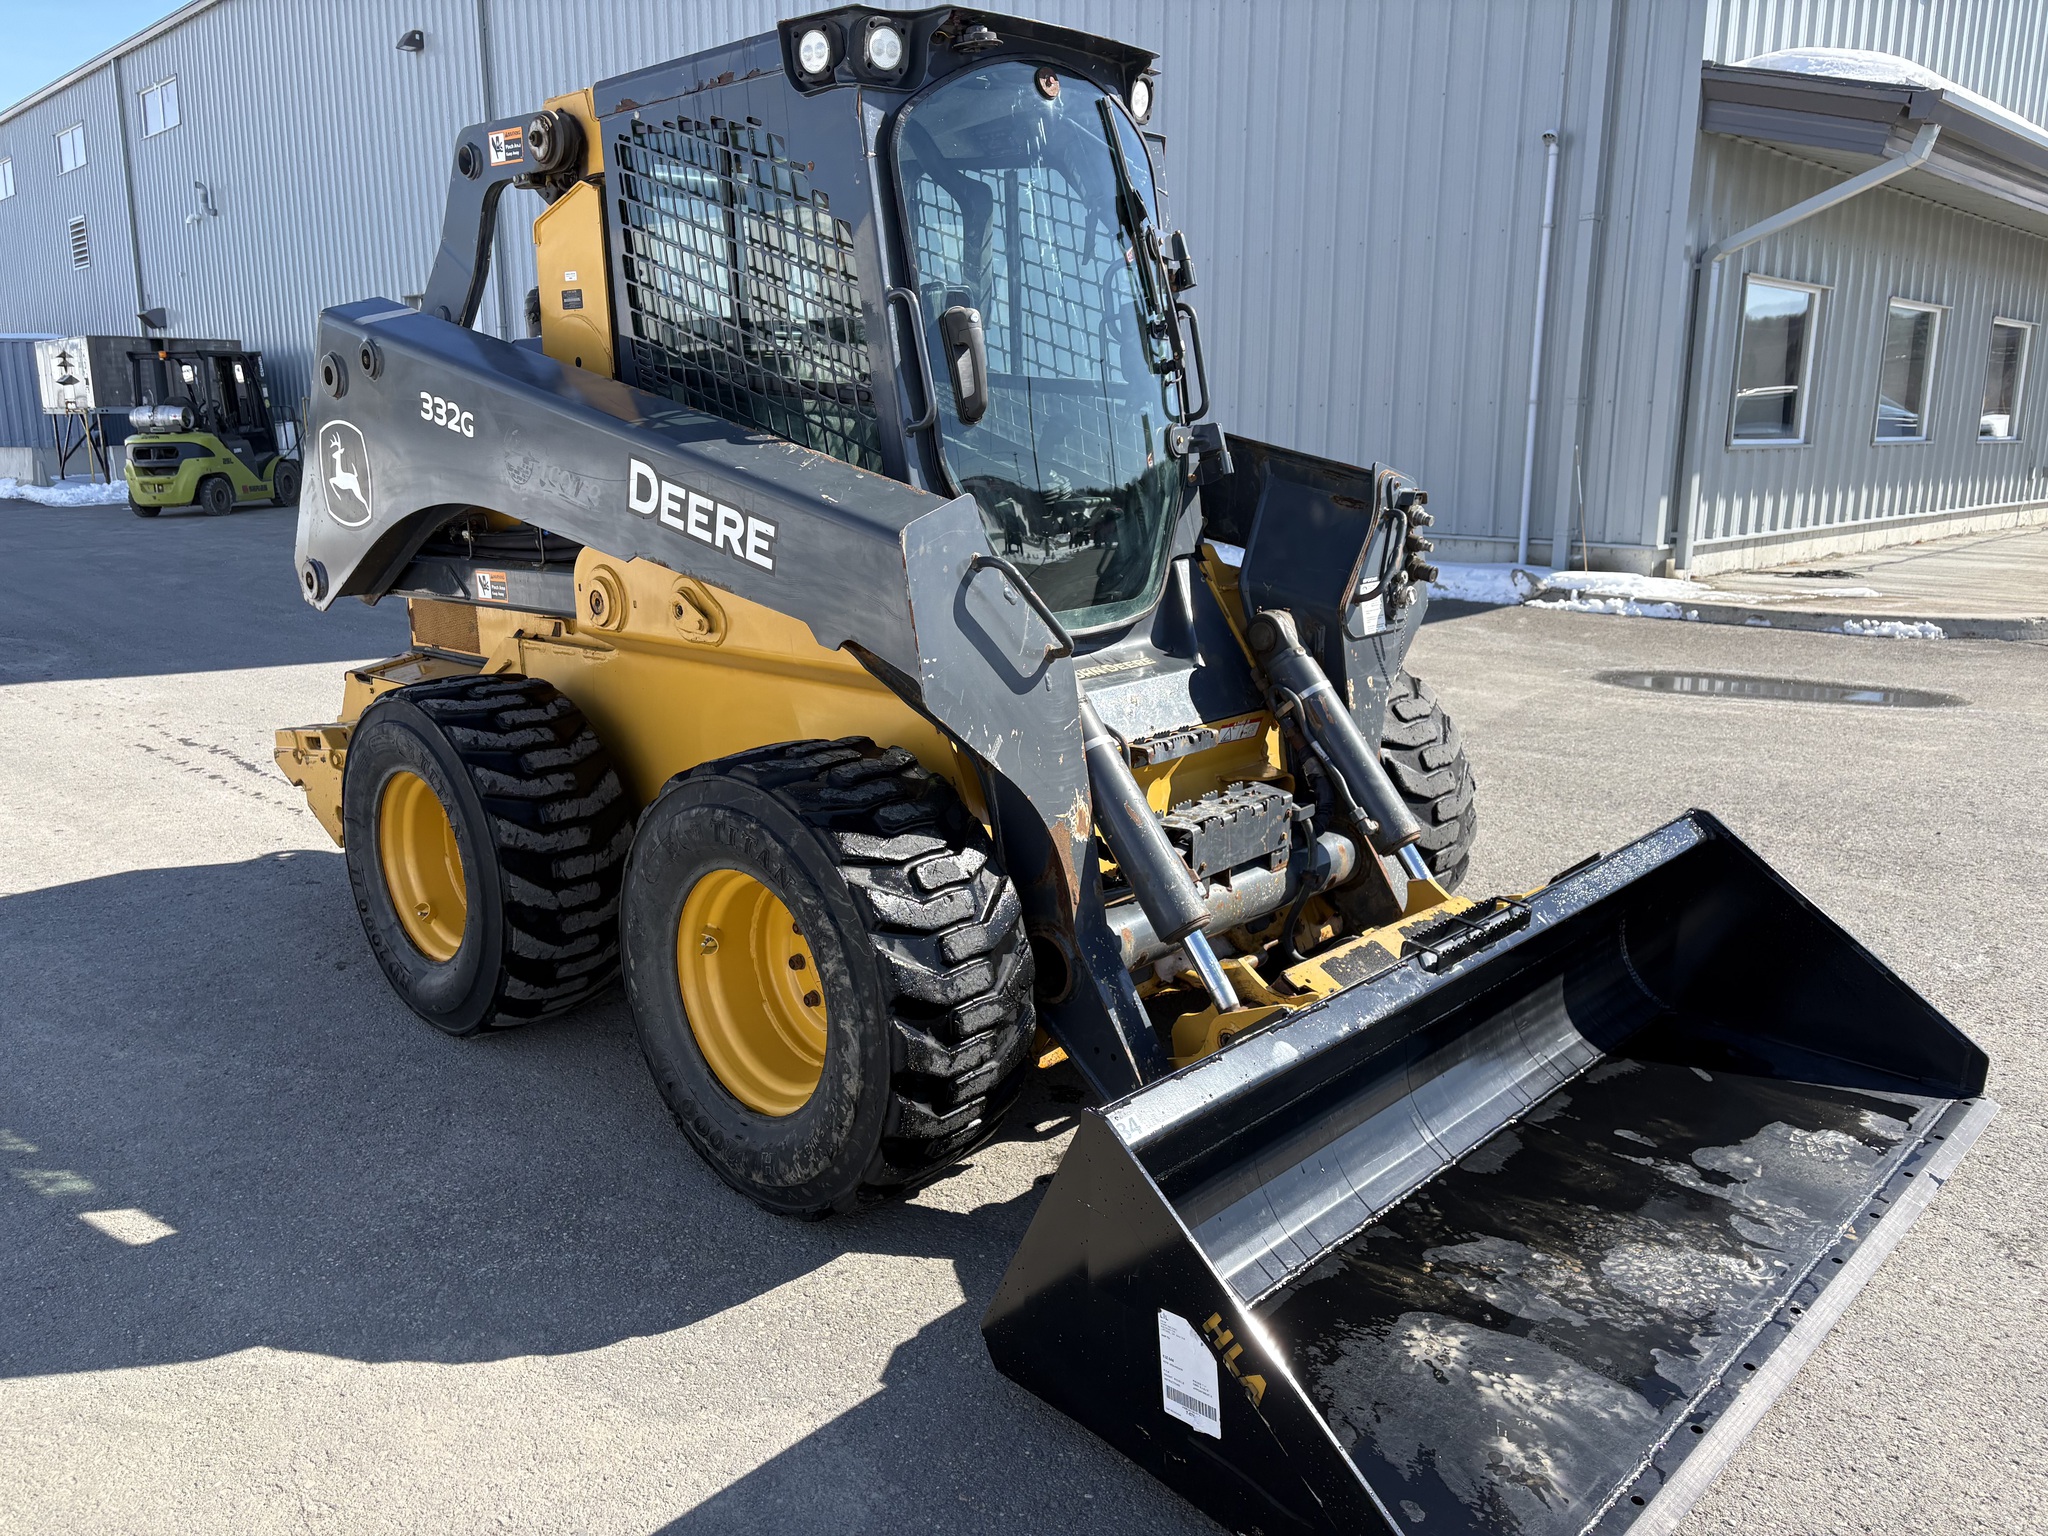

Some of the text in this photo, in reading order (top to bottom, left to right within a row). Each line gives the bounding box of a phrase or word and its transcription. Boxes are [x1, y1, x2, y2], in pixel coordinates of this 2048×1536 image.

[419, 391, 475, 439] 332G
[627, 457, 777, 571] DEERE
[1102, 656, 1157, 674] DEERE
[709, 817, 797, 892] TITAN
[1202, 1311, 1267, 1408] HLA
